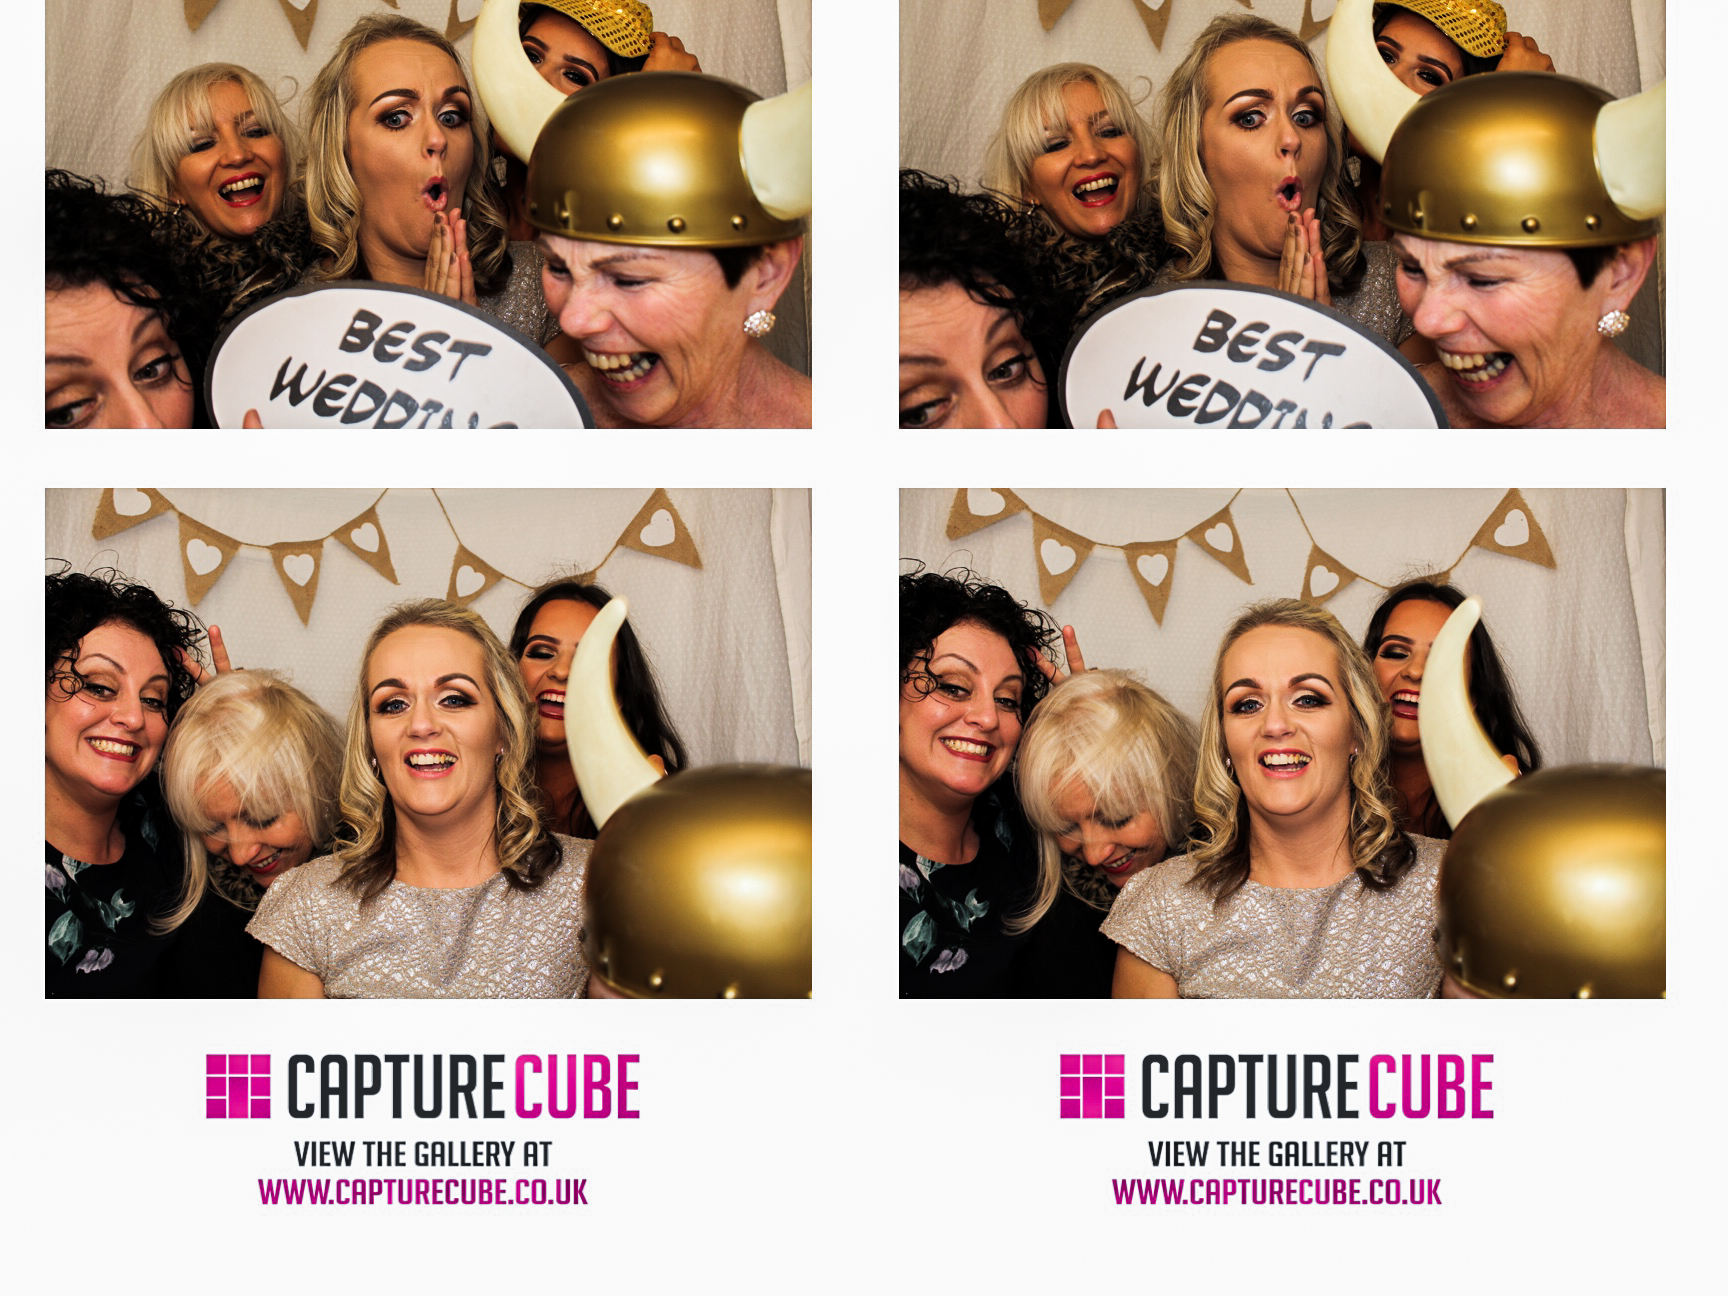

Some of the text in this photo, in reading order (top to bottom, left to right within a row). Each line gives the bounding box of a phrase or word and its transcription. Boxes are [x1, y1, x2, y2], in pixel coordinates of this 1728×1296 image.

[338, 308, 493, 381] BEST
[1192, 308, 1347, 381] BEST
[269, 356, 519, 429] WEDDI
[1123, 356, 1373, 429] WEDDI
